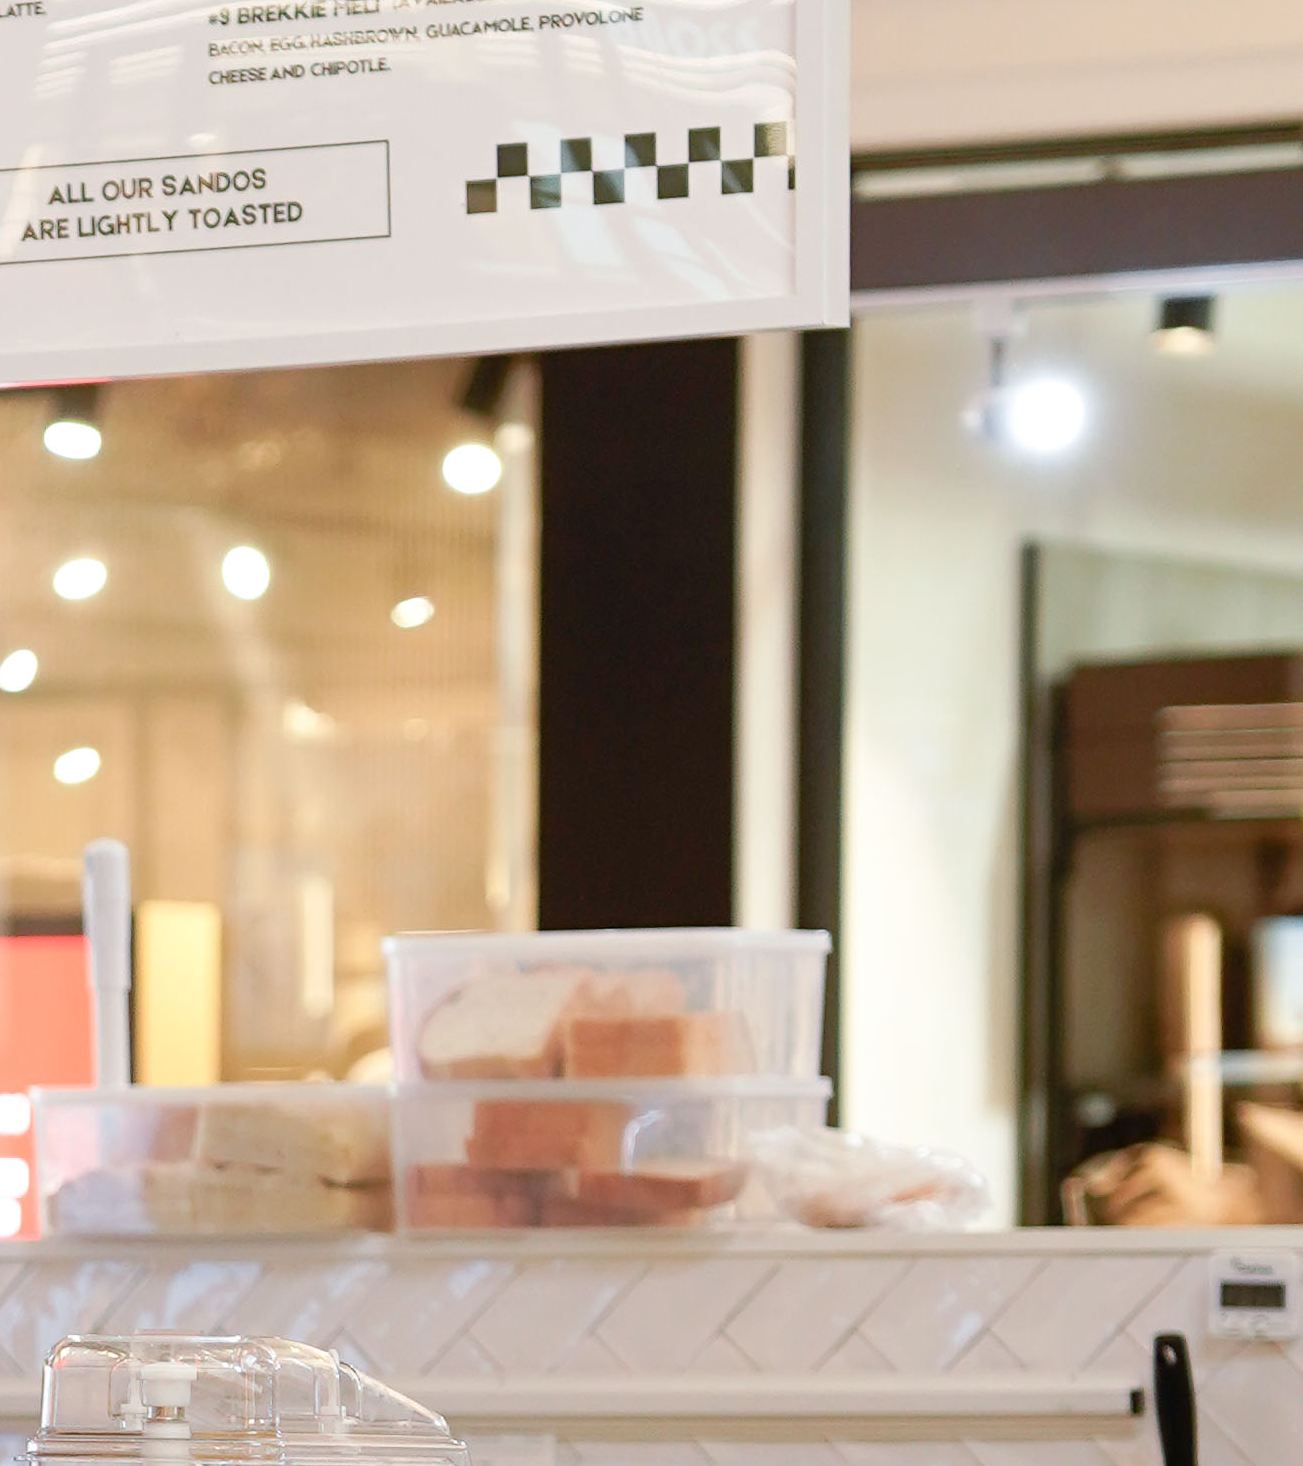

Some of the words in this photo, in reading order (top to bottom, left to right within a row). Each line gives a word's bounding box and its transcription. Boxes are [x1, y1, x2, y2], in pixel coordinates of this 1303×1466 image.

[46, 181, 95, 206] ALL
[100, 175, 154, 202] OUR
[160, 166, 267, 197] SANDOS
[19, 216, 70, 242] ARE
[75, 209, 179, 238] LIGHTLY
[186, 200, 304, 230] TOASTED
